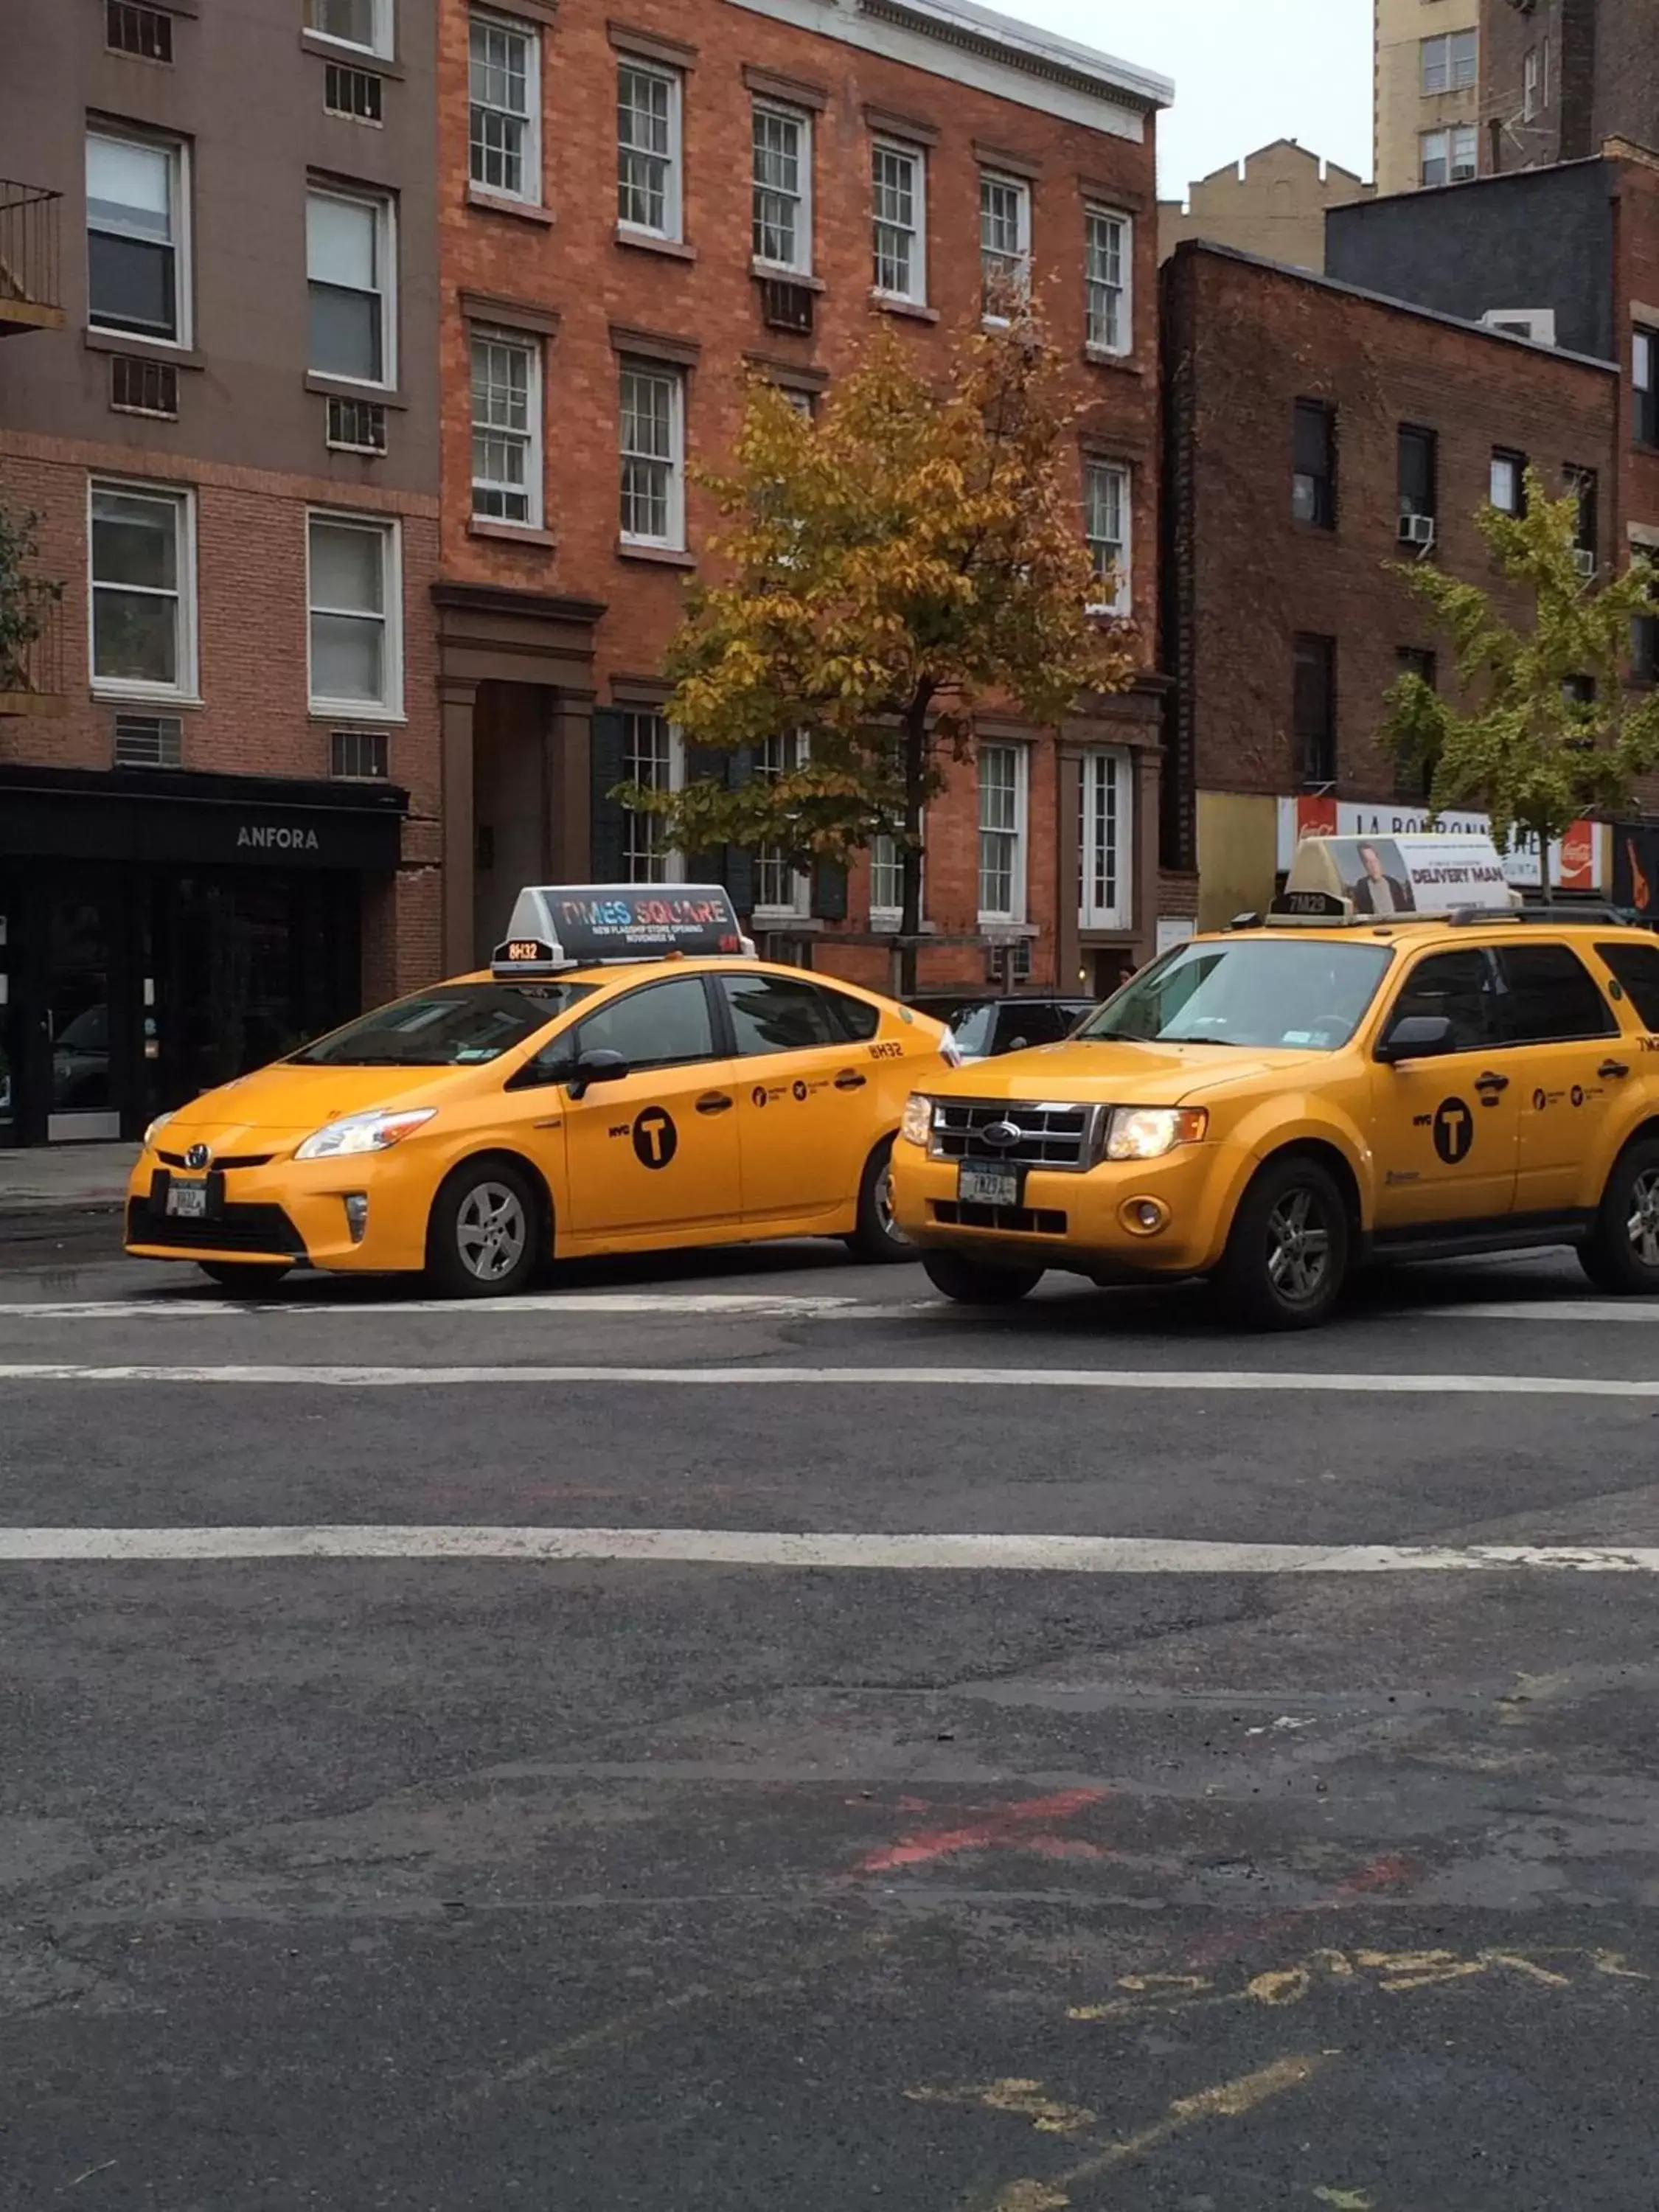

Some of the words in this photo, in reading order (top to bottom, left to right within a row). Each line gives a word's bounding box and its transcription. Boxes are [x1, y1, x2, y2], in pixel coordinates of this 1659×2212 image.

[237, 826, 319, 849] ANFORA
[1411, 868, 1468, 884] DELIVERY
[1471, 866, 1504, 883] MAN
[560, 900, 633, 925] TIMES
[634, 900, 728, 923] SQUARE
[1289, 894, 1326, 913] 7M29
[592, 925, 610, 934] NEW
[647, 925, 670, 933] STORE
[626, 934, 667, 943] NOVEMBER
[509, 943, 538, 959] 8H32
[868, 1042, 904, 1059] 8H32
[608, 1124, 630, 1138] NYC
[641, 1118, 667, 1161] T
[1442, 1110, 1464, 1156] T
